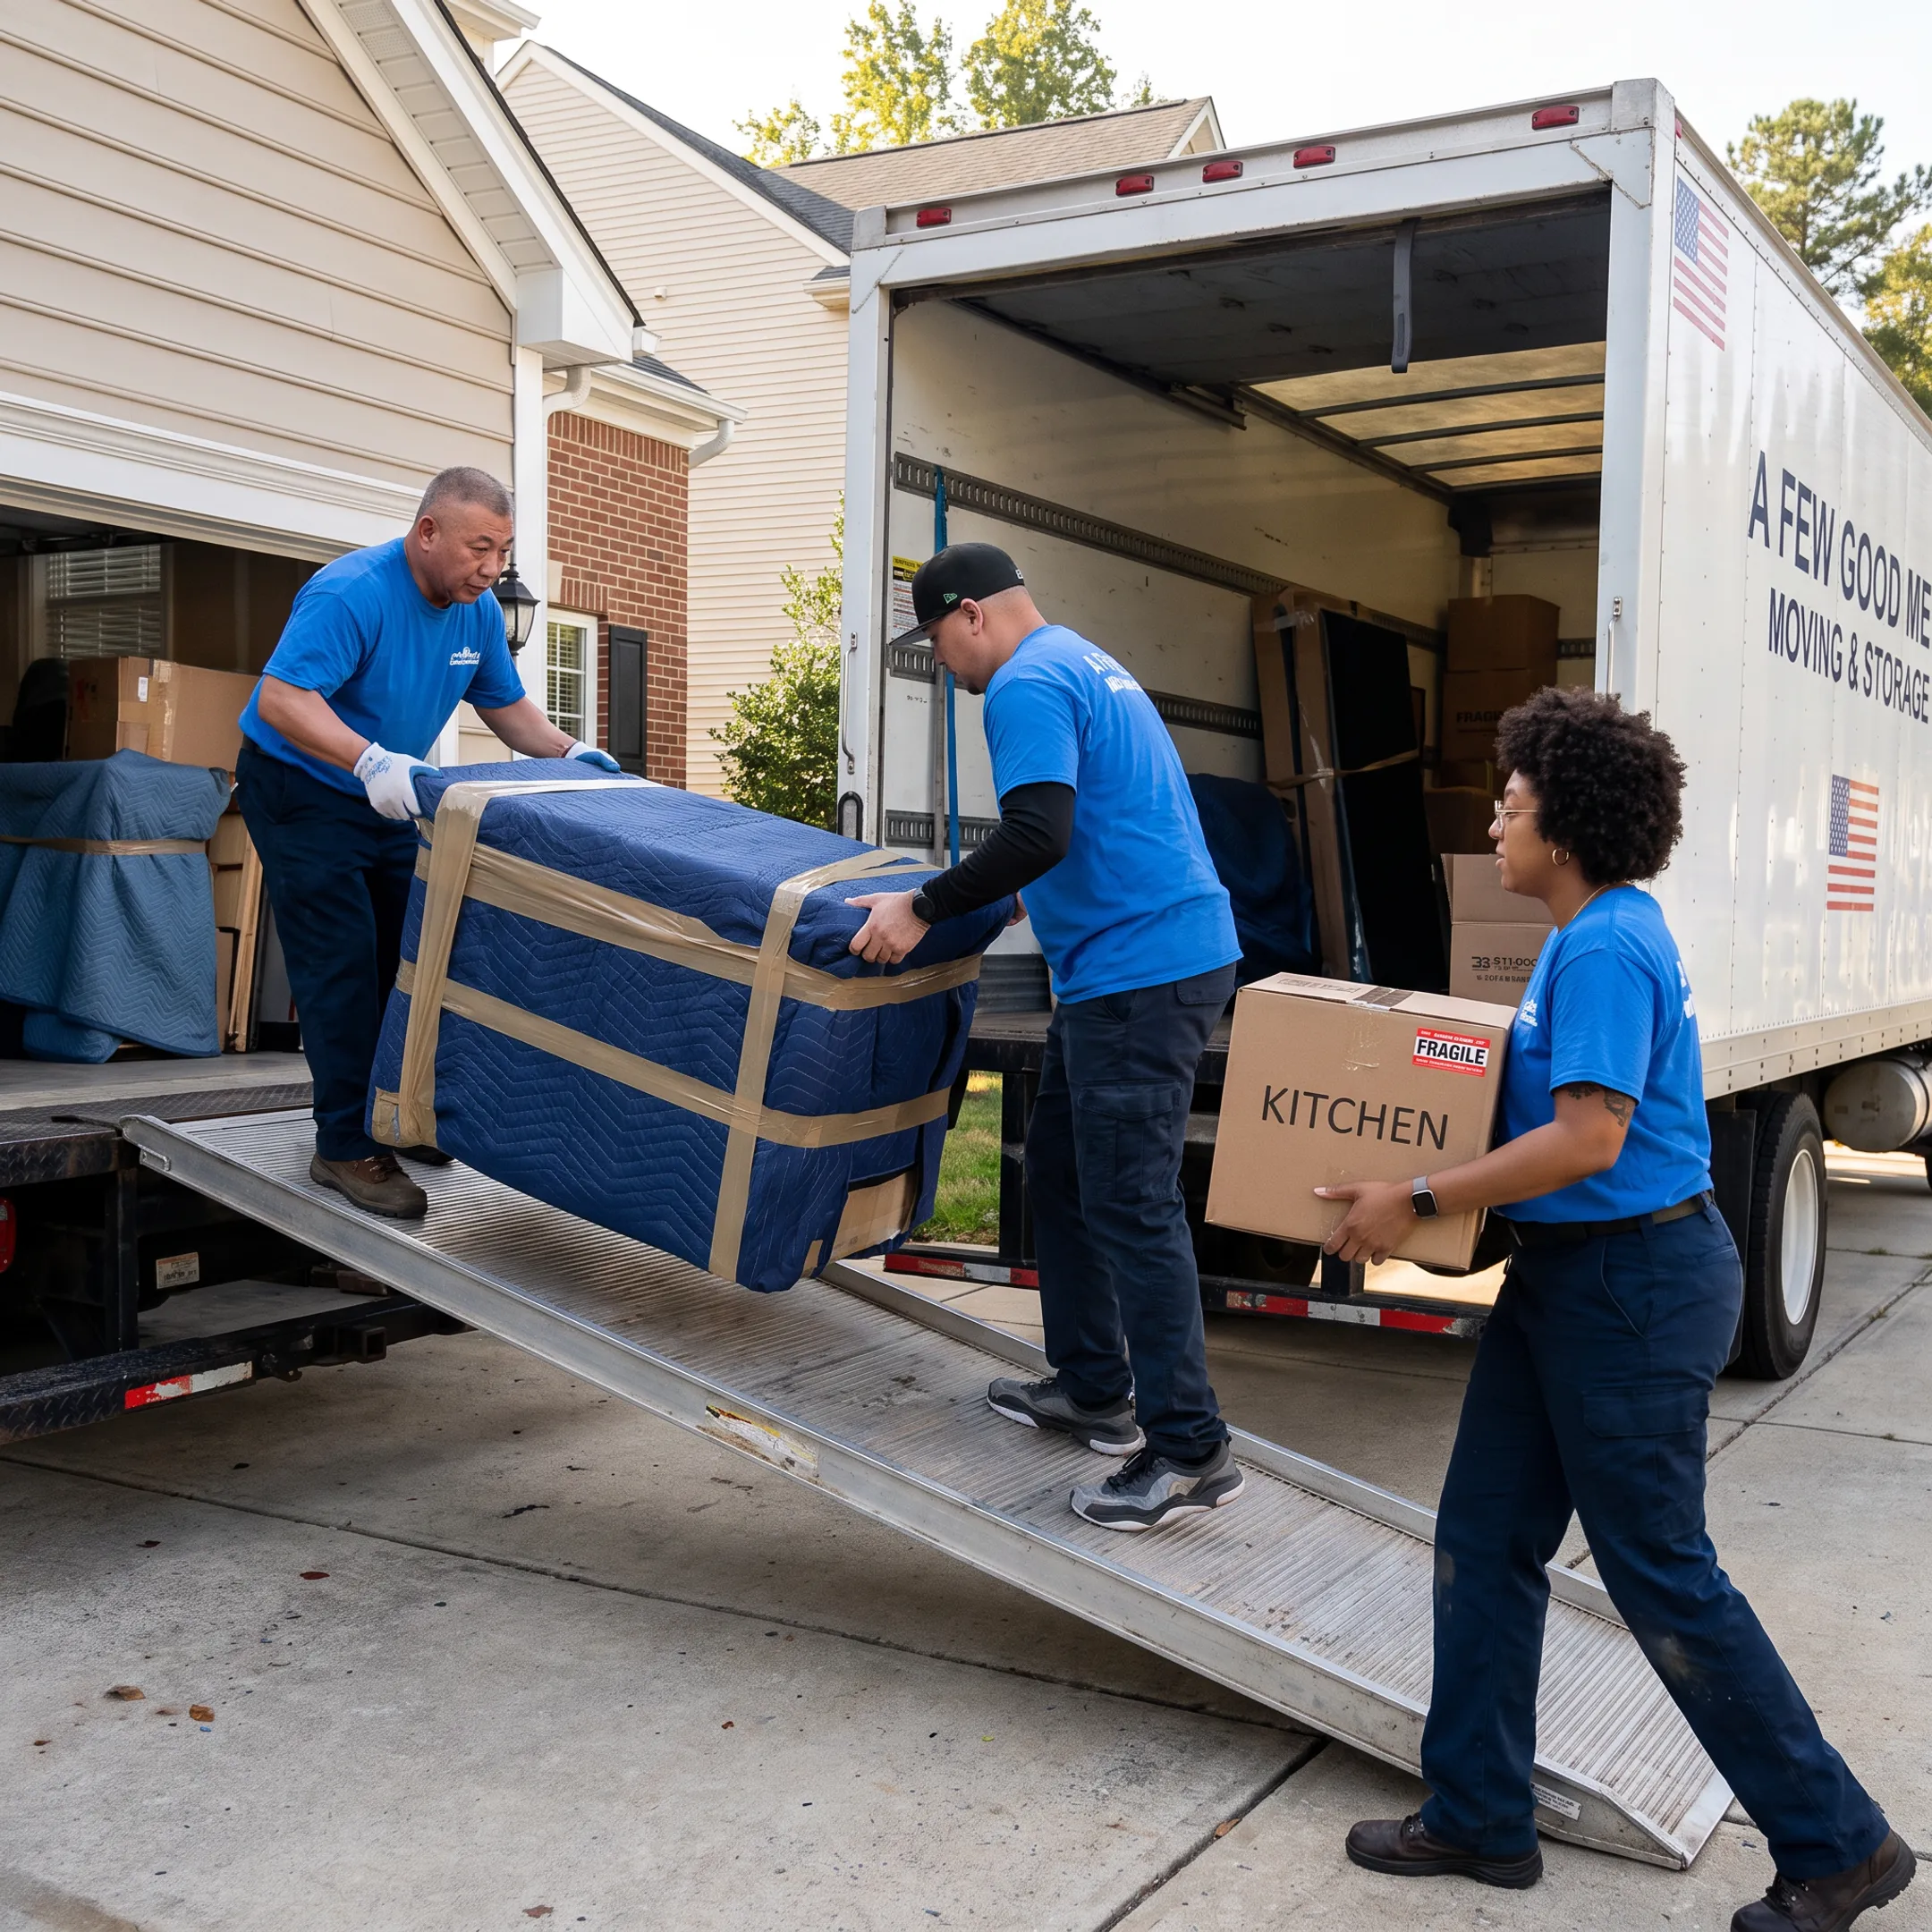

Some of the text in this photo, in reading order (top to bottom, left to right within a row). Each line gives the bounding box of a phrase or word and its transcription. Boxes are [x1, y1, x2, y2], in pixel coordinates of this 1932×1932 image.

[1749, 450, 1770, 549] A
[1778, 467, 1835, 587] FEW
[1840, 520, 1902, 628] GOOD
[1768, 587, 1930, 724] MOVING & STORAGE
[1416, 1038, 1486, 1065] FRAGILE
[1262, 1085, 1448, 1150] KITCHEN
